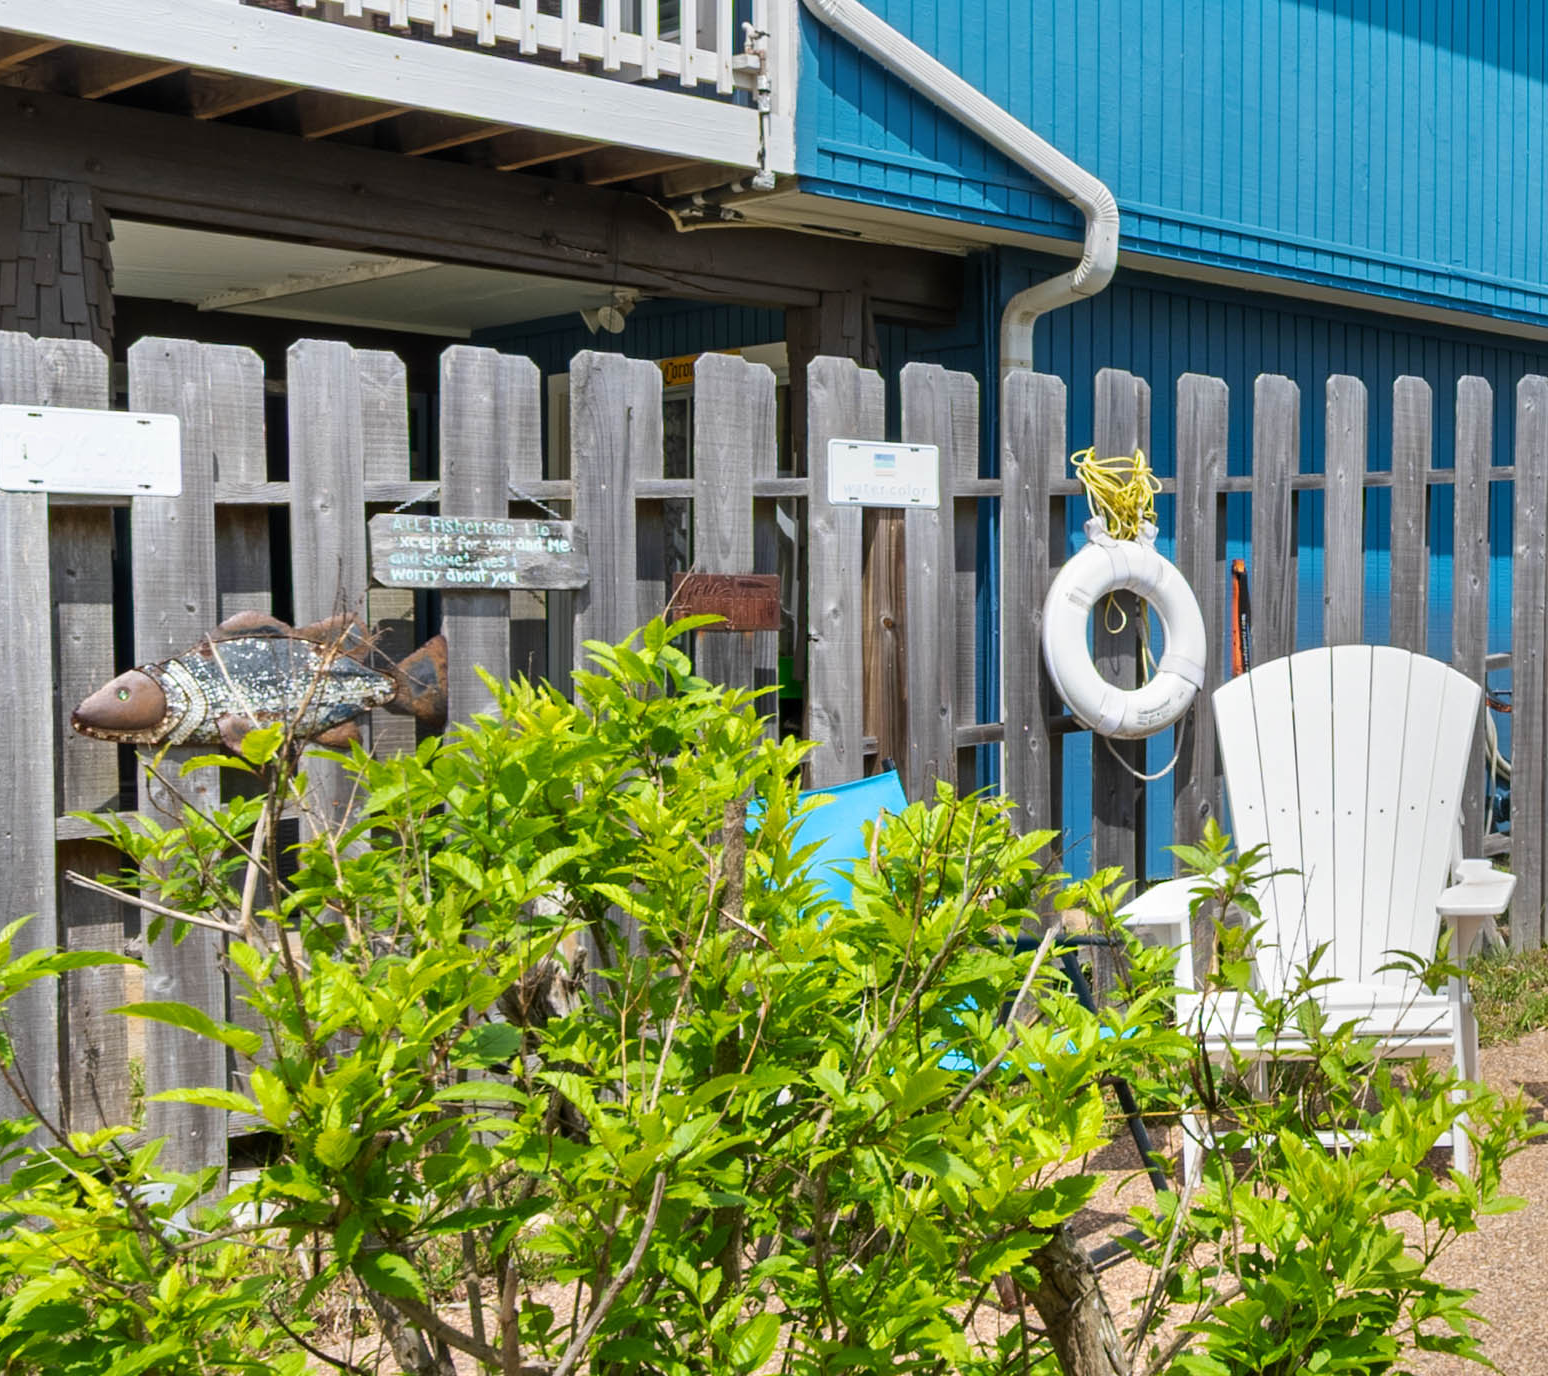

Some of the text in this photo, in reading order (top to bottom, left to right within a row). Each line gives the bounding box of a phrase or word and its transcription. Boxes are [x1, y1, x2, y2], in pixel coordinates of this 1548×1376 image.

[457, 536, 481, 551] for
[486, 538, 511, 552] you
[516, 536, 542, 551] and
[446, 567, 487, 582] about
[492, 573, 516, 587] you
